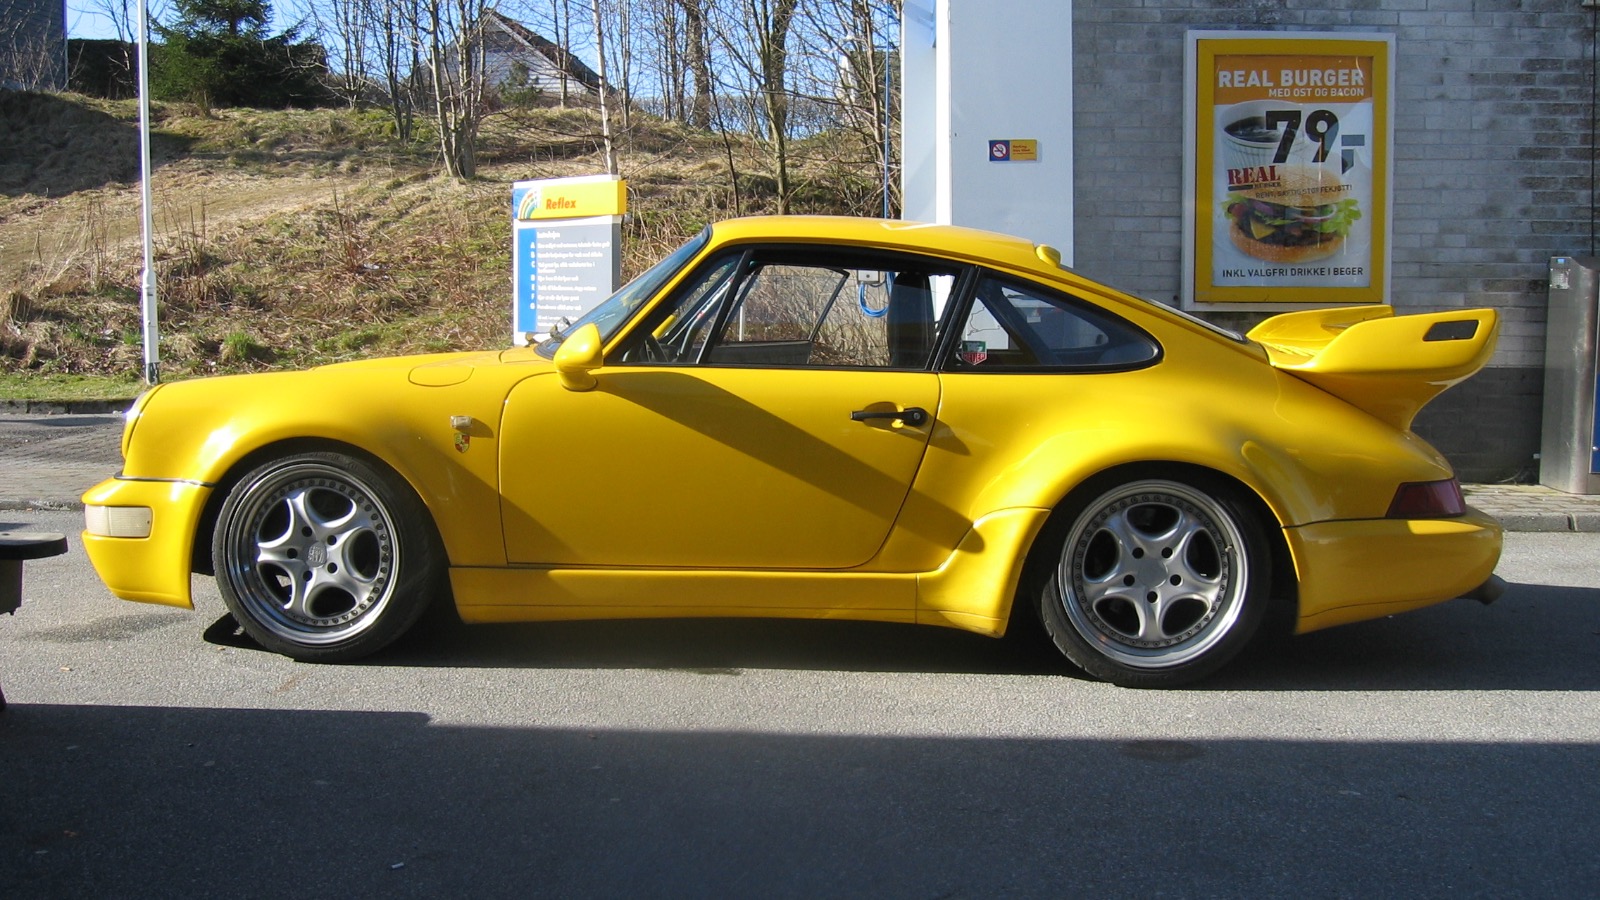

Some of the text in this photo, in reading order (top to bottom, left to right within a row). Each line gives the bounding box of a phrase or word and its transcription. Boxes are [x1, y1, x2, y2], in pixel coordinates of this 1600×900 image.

[1218, 68, 1364, 88] REAL BURGER
[1268, 87, 1364, 97] MED OST OG BACON
[1227, 165, 1280, 185] REAL
[546, 197, 577, 210] Reflex
[1222, 267, 1364, 278] INKL VALGFRI DRIKKE I BEGER
